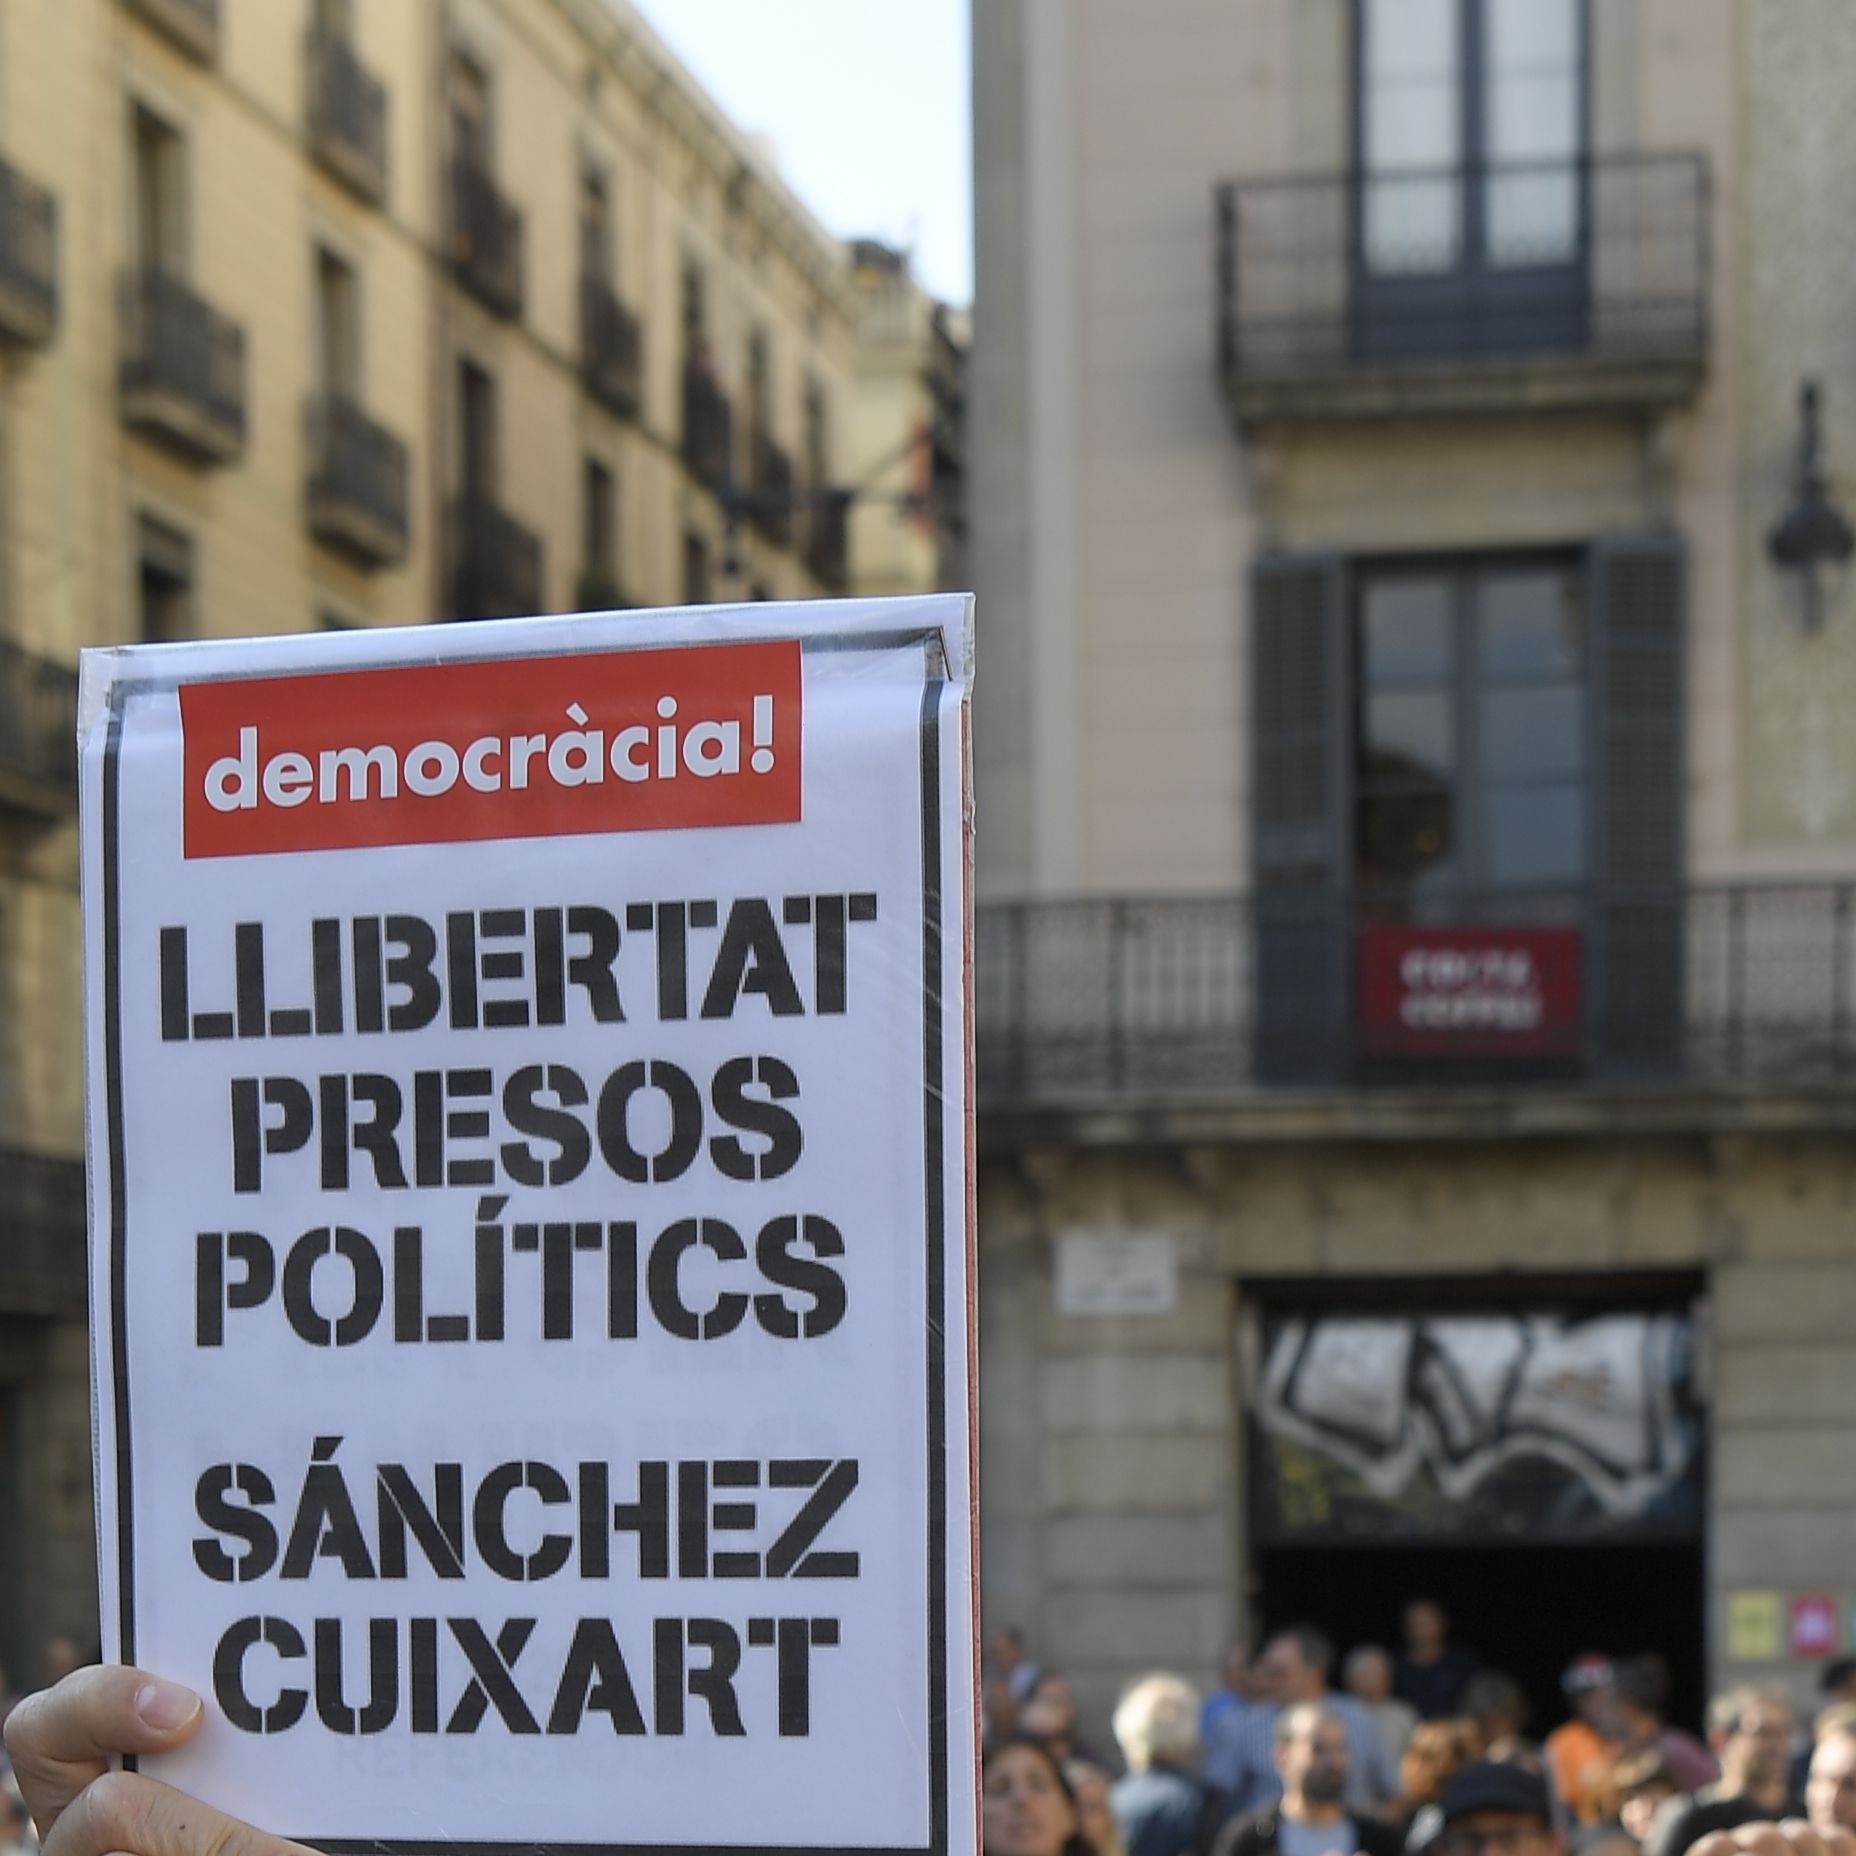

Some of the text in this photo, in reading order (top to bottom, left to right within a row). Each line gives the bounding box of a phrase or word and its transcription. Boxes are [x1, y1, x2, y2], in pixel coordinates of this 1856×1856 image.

[203, 693, 776, 813] democràcia!
[159, 892, 879, 1043] LLIBERTAT
[229, 1055, 803, 1195] PRESOS
[195, 1194, 848, 1348] POLÍTICS
[192, 1435, 861, 1584] SÁNCHEZ
[211, 1615, 840, 1738] CUIXART
